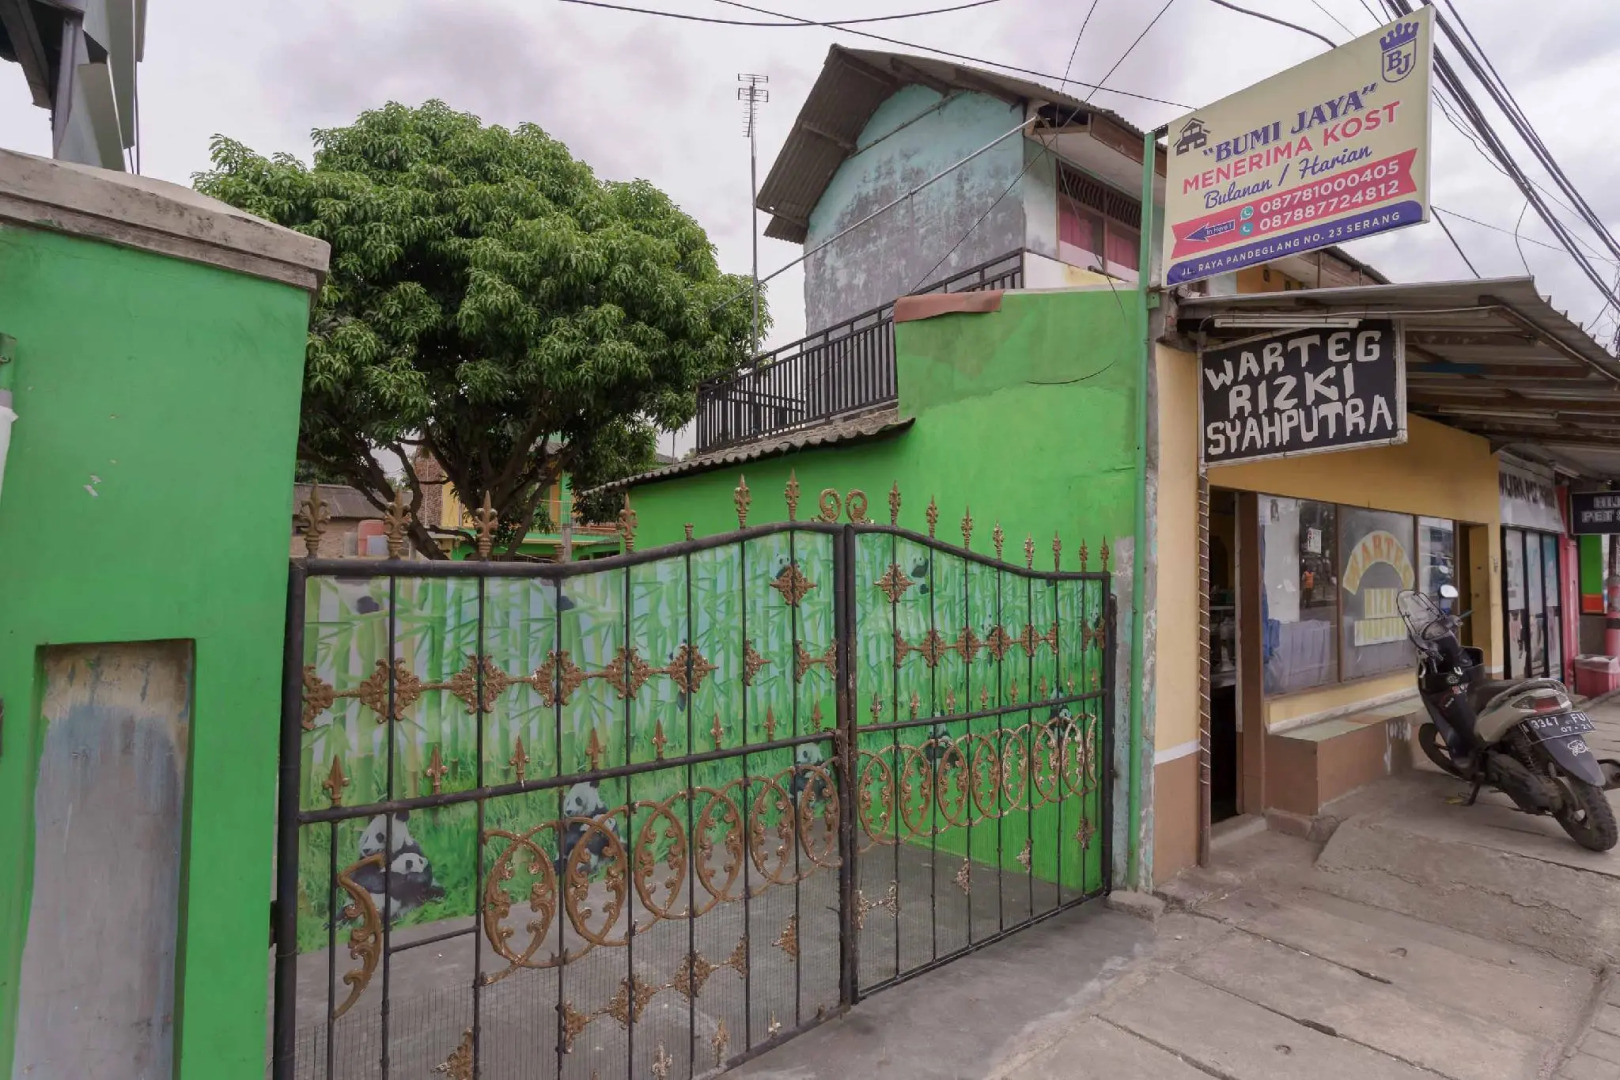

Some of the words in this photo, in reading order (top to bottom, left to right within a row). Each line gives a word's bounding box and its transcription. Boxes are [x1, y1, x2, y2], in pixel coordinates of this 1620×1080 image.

[1386, 50, 1411, 75] BJ
[1183, 136, 1313, 195] MENERIMA
[1323, 101, 1400, 147] KOST
[1204, 179, 1272, 209] Bulanan
[1299, 146, 1372, 179] Harian
[1259, 180, 1399, 231] 087887724812
[1260, 160, 1399, 214] 087781000405
[1181, 267, 1196, 276] JL.
[1198, 259, 1224, 272] RAYA
[1226, 238, 1300, 265] PANDEGLANG
[1304, 233, 1325, 245] NO.
[1328, 227, 1343, 238] 23
[1346, 211, 1400, 233] SERANG
[1204, 330, 1382, 391] WARTEG
[1228, 363, 1355, 420] RIZKI
[1206, 394, 1394, 456] SYAHPUTRA
[1581, 509, 1614, 523] PET
[1570, 713, 1587, 724] FU
